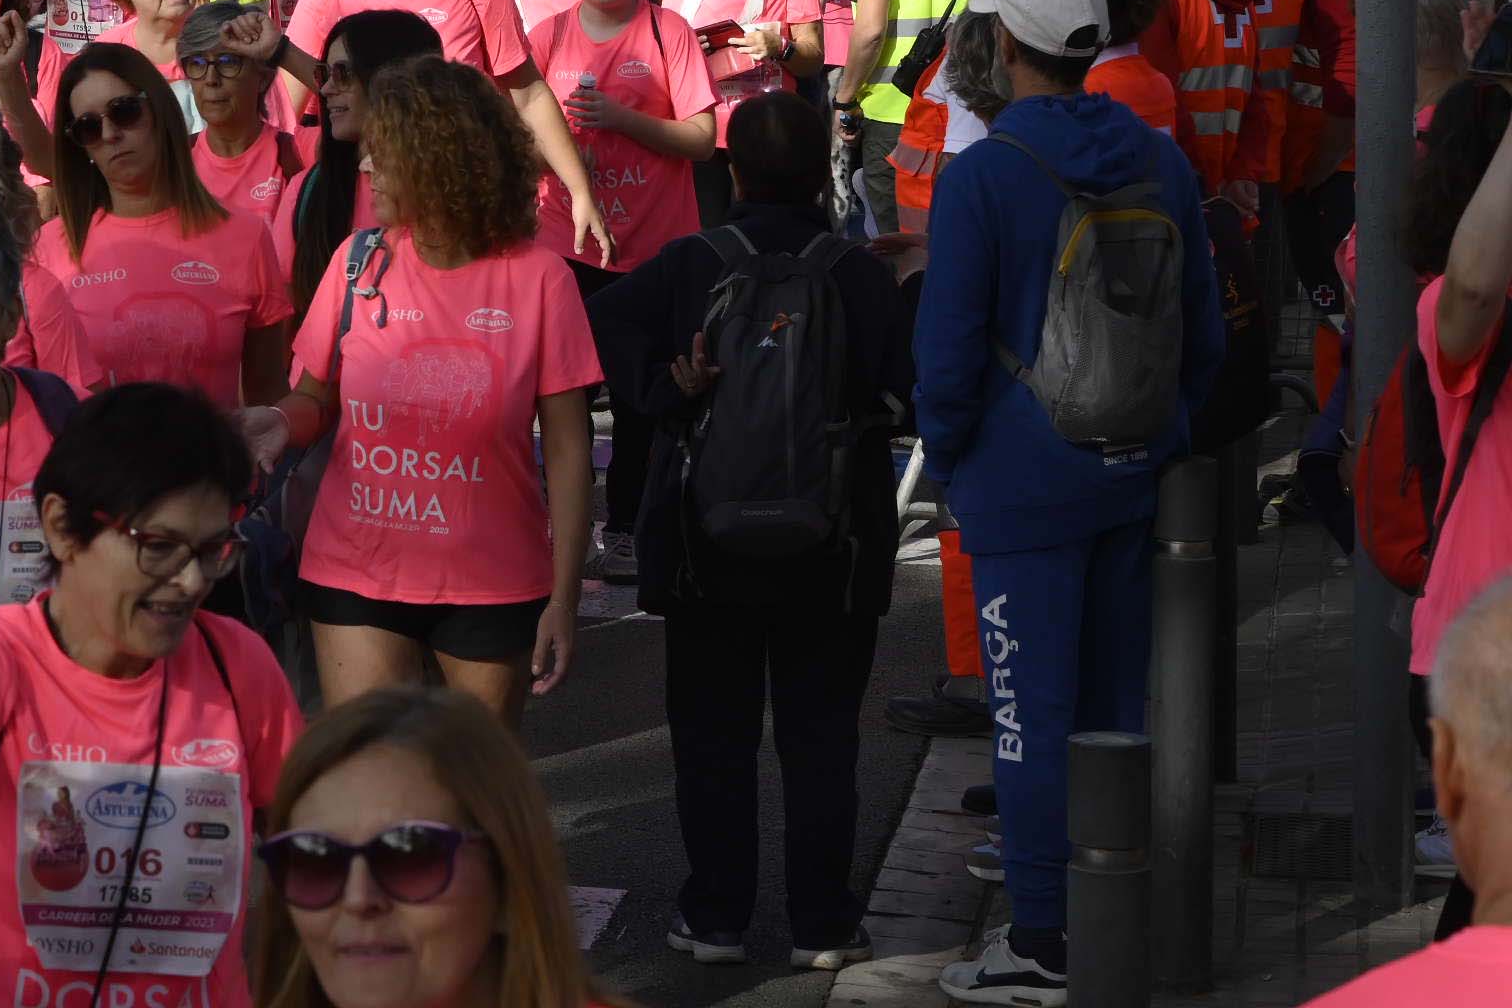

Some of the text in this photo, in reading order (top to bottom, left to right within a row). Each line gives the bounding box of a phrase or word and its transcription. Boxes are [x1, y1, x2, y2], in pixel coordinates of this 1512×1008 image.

[71, 266, 128, 289] OYSHO
[347, 398, 384, 432] TU
[351, 439, 485, 484] DORSAL
[349, 481, 447, 524] SUMA
[981, 592, 1024, 763] BARÇA
[28, 732, 108, 763] OSHO
[185, 794, 228, 809] SUMA
[94, 846, 163, 877] 016
[99, 885, 153, 905] 1785
[138, 912, 180, 927] MUJER
